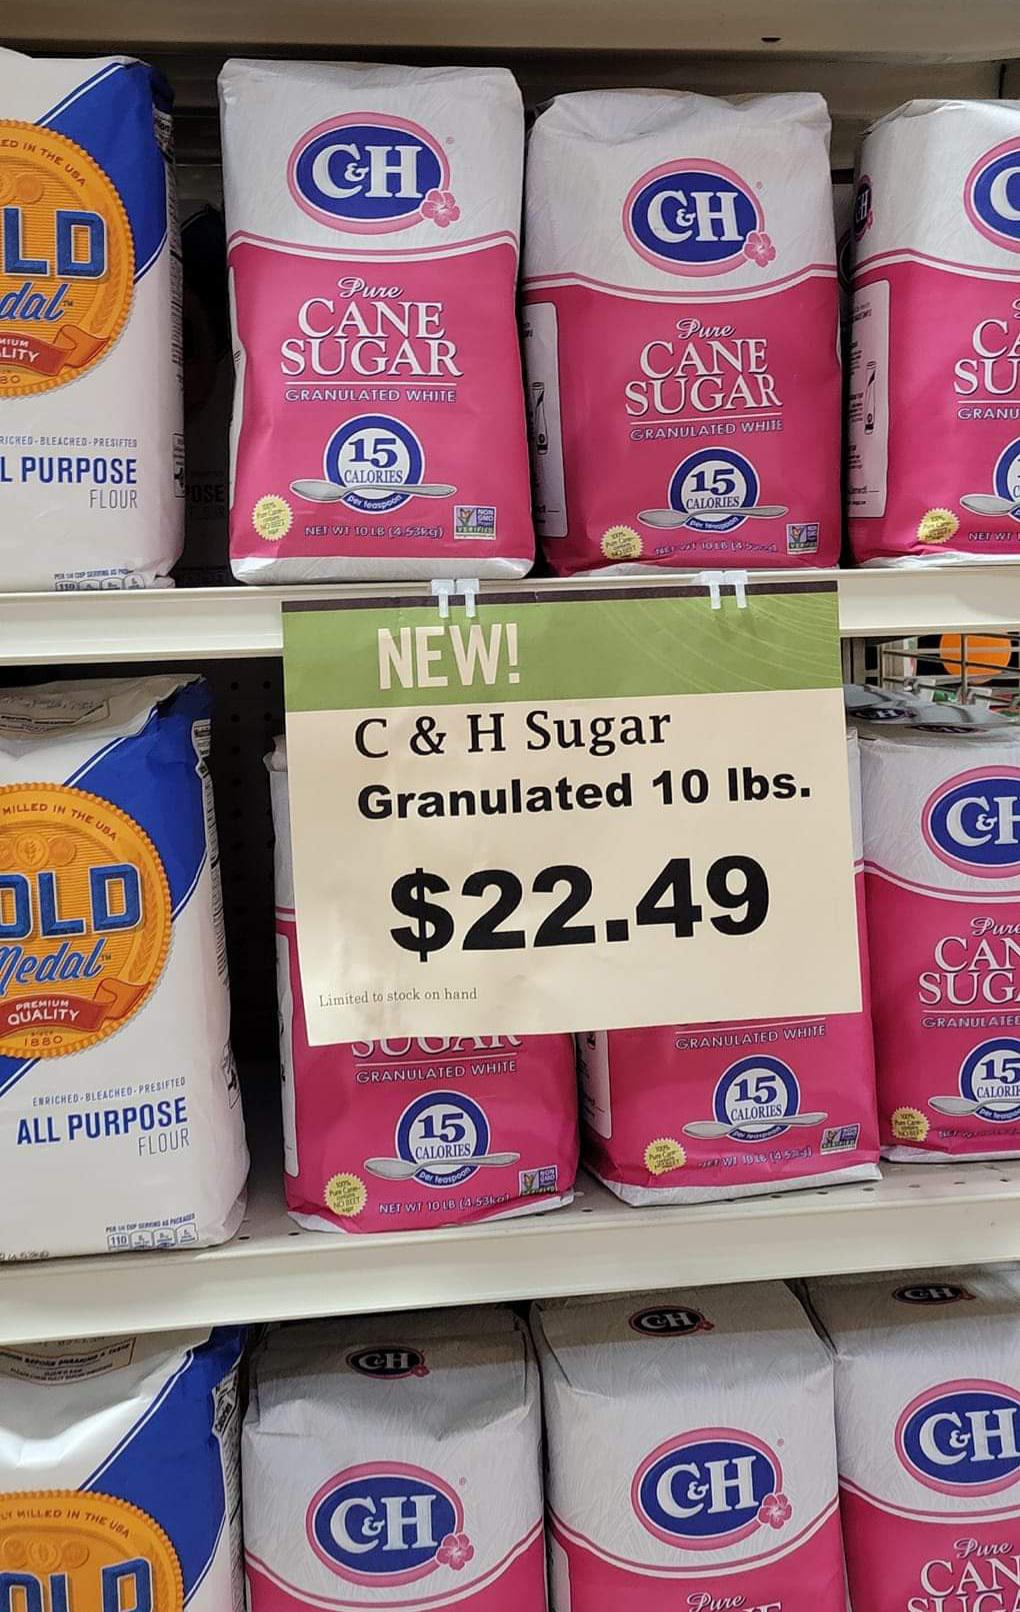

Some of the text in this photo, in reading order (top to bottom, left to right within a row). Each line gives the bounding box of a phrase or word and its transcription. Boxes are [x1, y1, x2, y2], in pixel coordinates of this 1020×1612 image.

[23, 143, 36, 153] IN
[40, 148, 61, 166] THE
[64, 164, 86, 186] USA
[311, 143, 424, 199] C&H
[647, 189, 744, 243] C&H
[3, 206, 108, 279] LD
[337, 276, 404, 299] Pure
[298, 298, 446, 339] CANE
[676, 318, 735, 340] Pure
[972, 318, 1020, 359] C
[280, 338, 464, 377] SUGAR
[640, 338, 768, 379] CANE
[285, 388, 456, 403] GRANULATED WHITE
[624, 374, 783, 417] SUGAR
[630, 418, 783, 442] GRANULATED WHITE
[348, 437, 398, 468] 15
[21, 456, 137, 484] PURPOSE
[344, 469, 404, 485] CALORIES
[691, 468, 736, 497] 15
[89, 488, 138, 509] FLOUR
[347, 494, 403, 511] per teaspoon
[686, 496, 740, 511] CALORIES
[304, 525, 329, 536] NET
[332, 526, 351, 537] WT
[355, 526, 369, 537] 10
[371, 526, 385, 537] LB
[378, 622, 520, 690] NEW!
[354, 709, 672, 759] C & H Sugar
[357, 766, 812, 821] Granulated 10 lbs.
[3, 803, 118, 843] MILLED IN THE USA
[389, 854, 770, 963] $22.49
[970, 917, 1020, 937] Pure
[319, 987, 478, 1008] Limited to stock on hand
[919, 971, 1020, 1006] SUG
[7, 1009, 80, 1026] QUALITY
[16, 999, 69, 1012] PREMIUM
[24, 1035, 63, 1048] 1880
[675, 1025, 825, 1050] GRANULATED WHITE
[356, 1060, 517, 1084] GRANULATED WHITE
[733, 1075, 778, 1104] 15
[17, 1097, 188, 1146] ALL PURPOSE
[730, 1104, 782, 1122] CALORIES
[138, 1128, 190, 1156] FLOUR
[418, 1113, 466, 1143] 15
[415, 1143, 471, 1161] CALORIES
[419, 1166, 471, 1184] per teaspoon
[379, 1203, 402, 1214] NET
[405, 1202, 422, 1213] WT
[427, 1201, 440, 1212] 10
[442, 1200, 456, 1211] LB
[110, 1235, 128, 1244] 110
[919, 1407, 1020, 1466] C&H
[656, 1455, 759, 1519] C&H
[17, 1509, 62, 1519] MILLED
[67, 1510, 80, 1520] IN
[85, 1512, 106, 1526] THE
[109, 1520, 130, 1539] USA
[330, 1494, 438, 1554] C&H
[953, 1537, 1013, 1559] Pure
